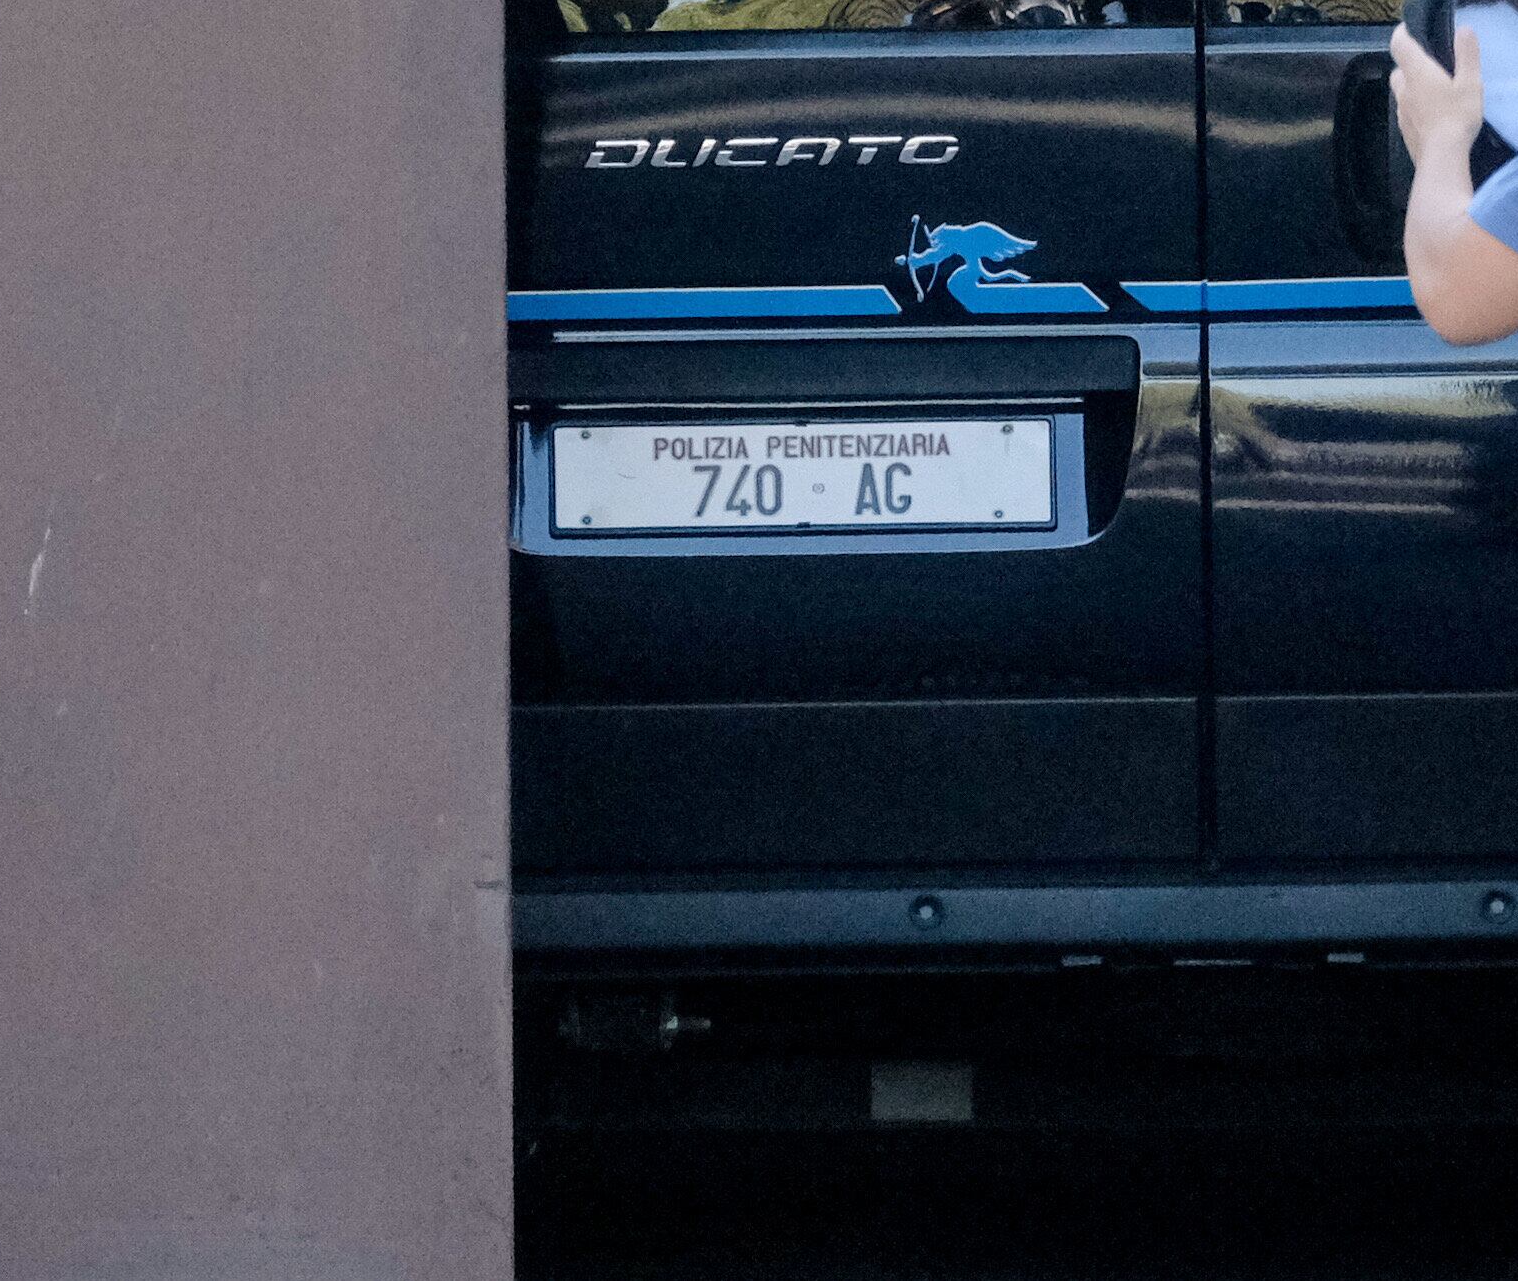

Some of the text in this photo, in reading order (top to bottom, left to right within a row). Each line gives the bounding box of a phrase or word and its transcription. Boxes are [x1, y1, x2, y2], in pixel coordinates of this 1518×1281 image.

[584, 135, 961, 169] DUCATO
[653, 433, 951, 460] POLIZIA PENITENZIARIA
[692, 461, 913, 518] 740 AG
